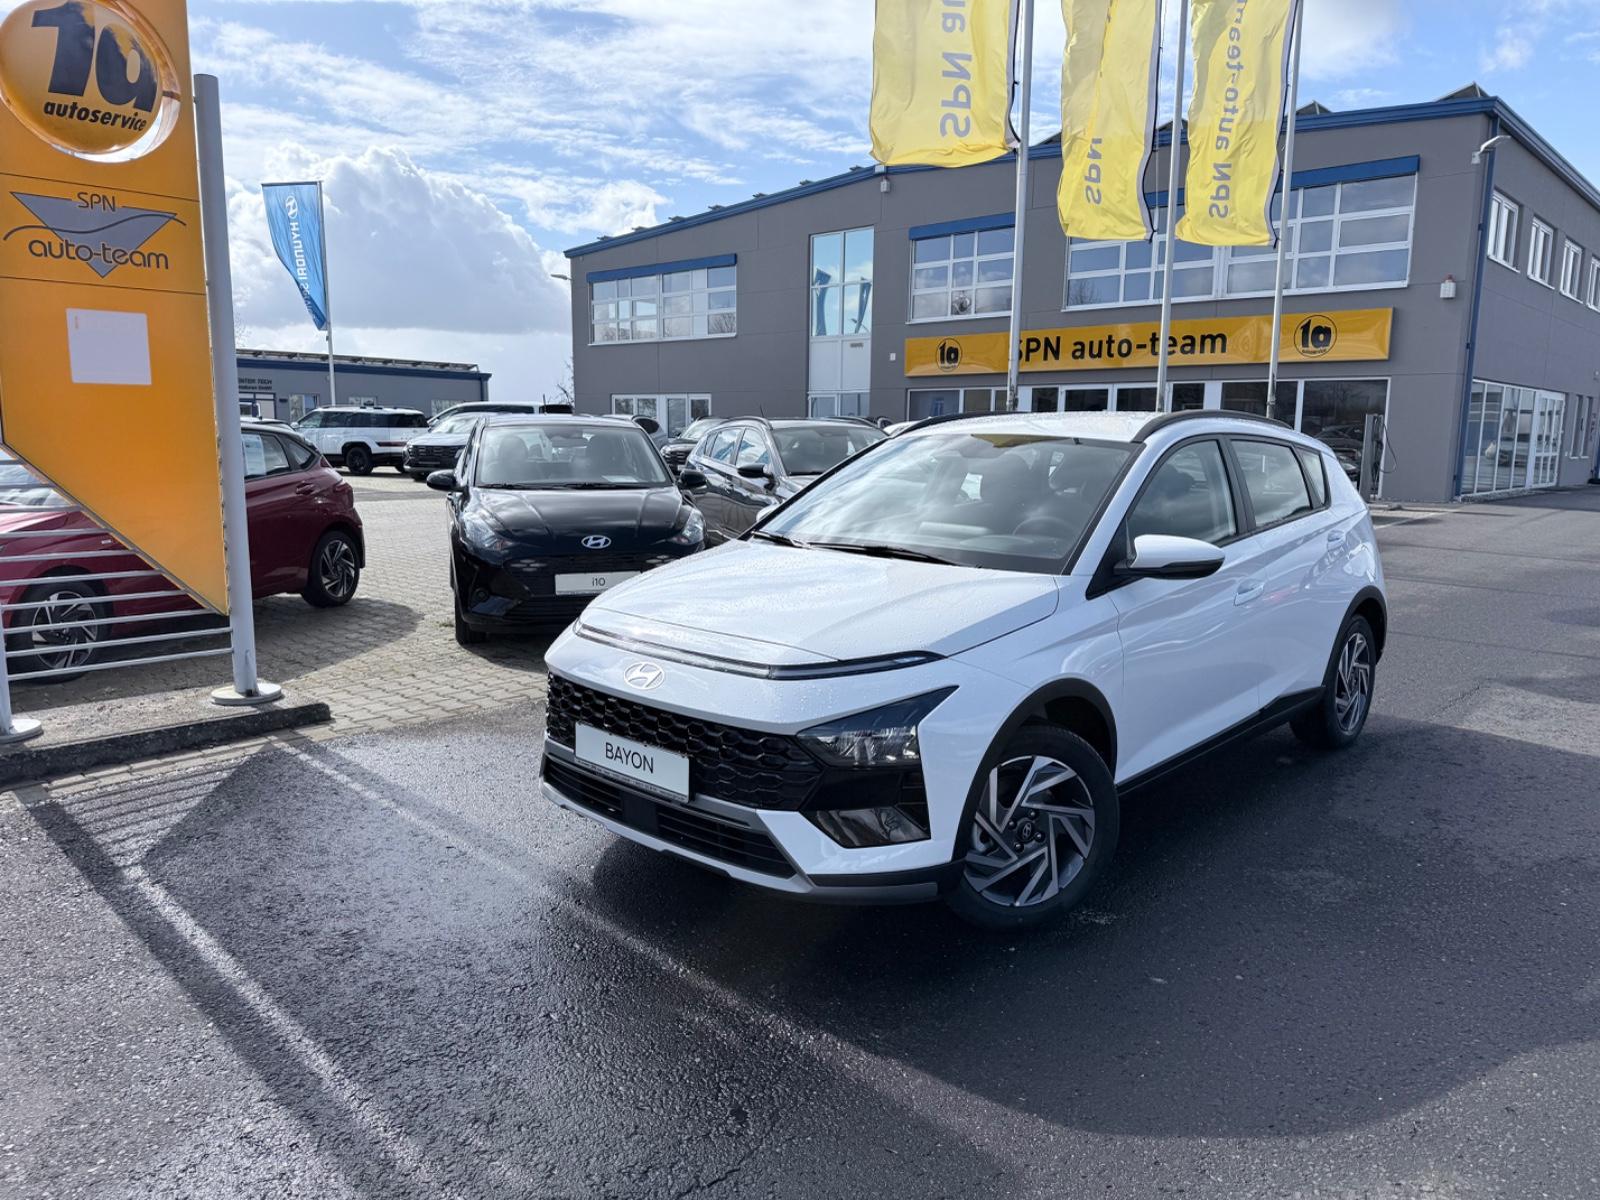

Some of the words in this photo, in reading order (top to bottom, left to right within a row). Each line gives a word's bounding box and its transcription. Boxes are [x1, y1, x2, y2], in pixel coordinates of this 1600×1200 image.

[43, 101, 147, 132] autoservice
[77, 192, 117, 212] SPN
[28, 239, 169, 270] auto-team
[1019, 336, 1061, 362] PN
[1071, 331, 1228, 360] auto-team
[1300, 319, 1332, 349] 1a
[939, 341, 960, 365] 1a
[605, 741, 655, 774] BAYON
